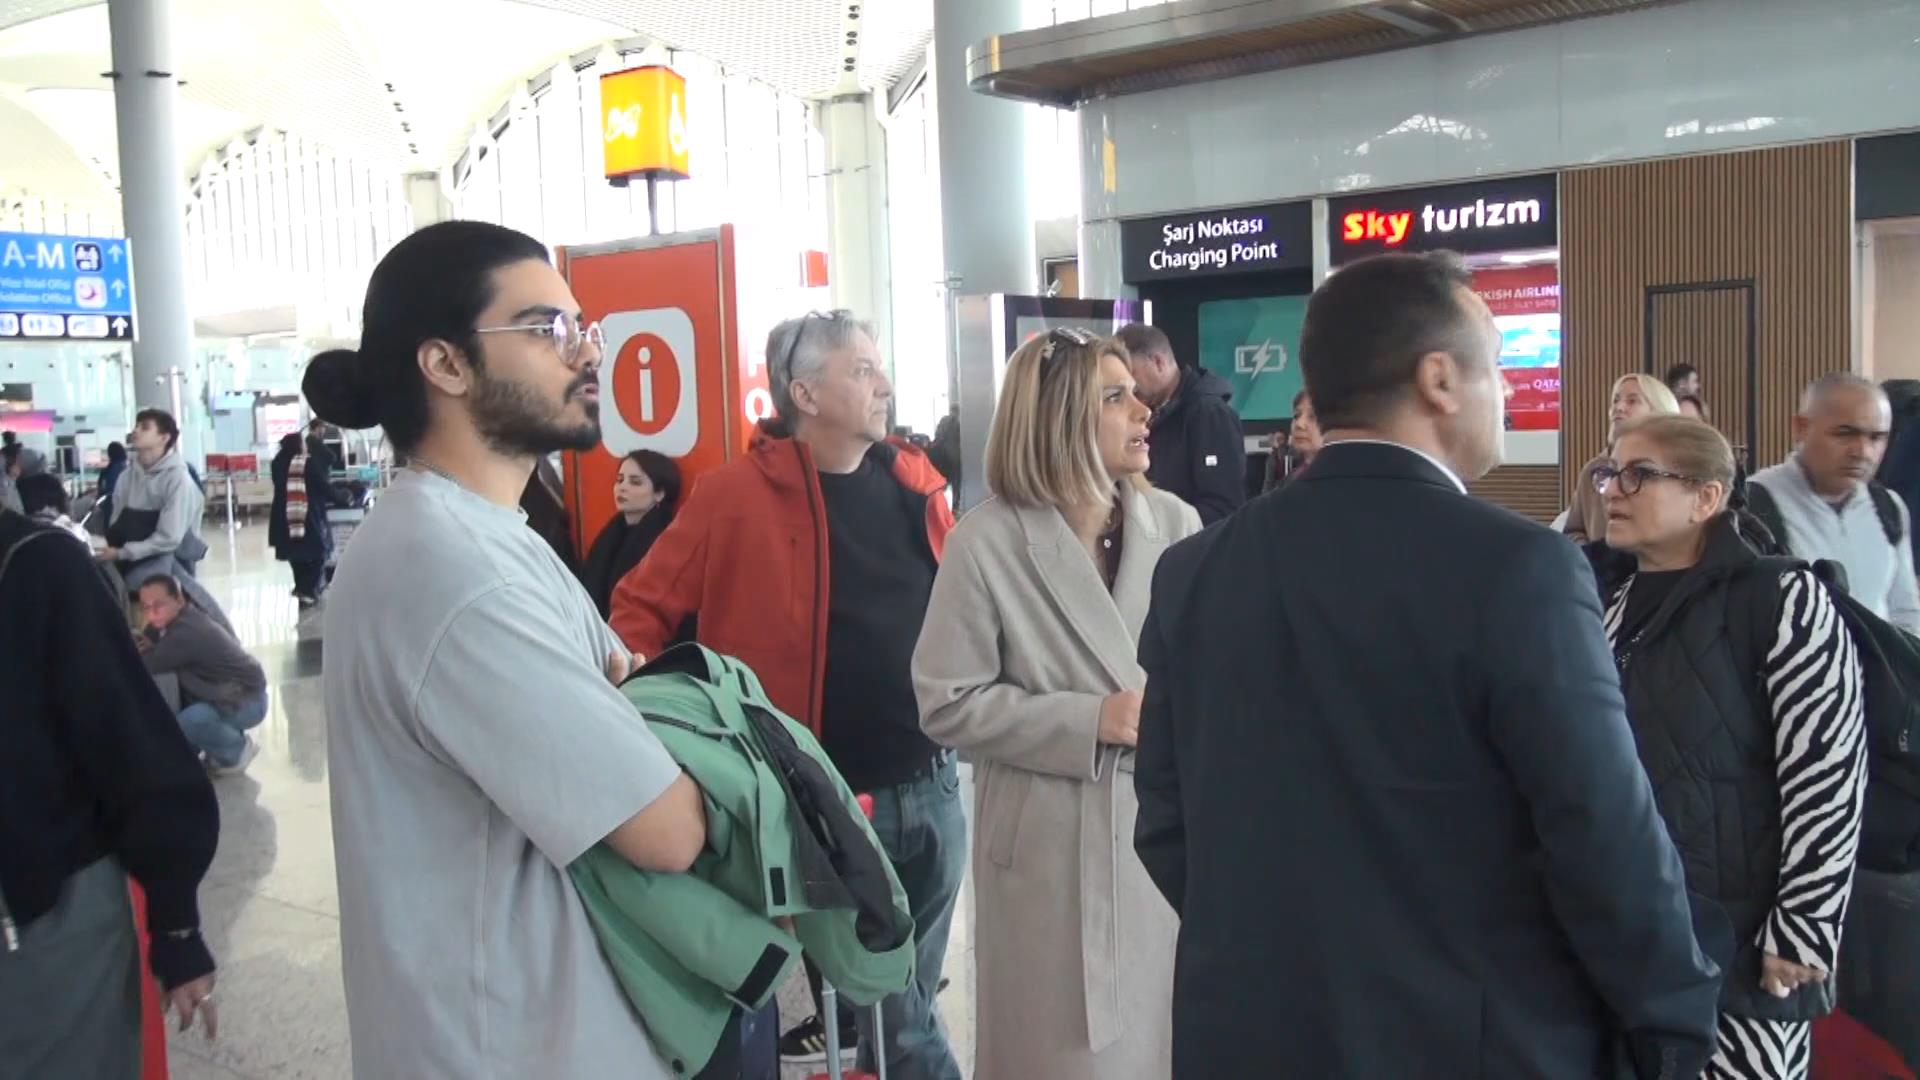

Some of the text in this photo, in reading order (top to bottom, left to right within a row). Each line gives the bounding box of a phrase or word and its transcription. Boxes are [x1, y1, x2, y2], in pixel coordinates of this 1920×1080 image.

[1162, 217, 1264, 246] Şarj Noktası
[1343, 199, 1541, 244] Sky turizm
[3, 240, 65, 269] A-M
[1149, 243, 1279, 271] Charging Point
